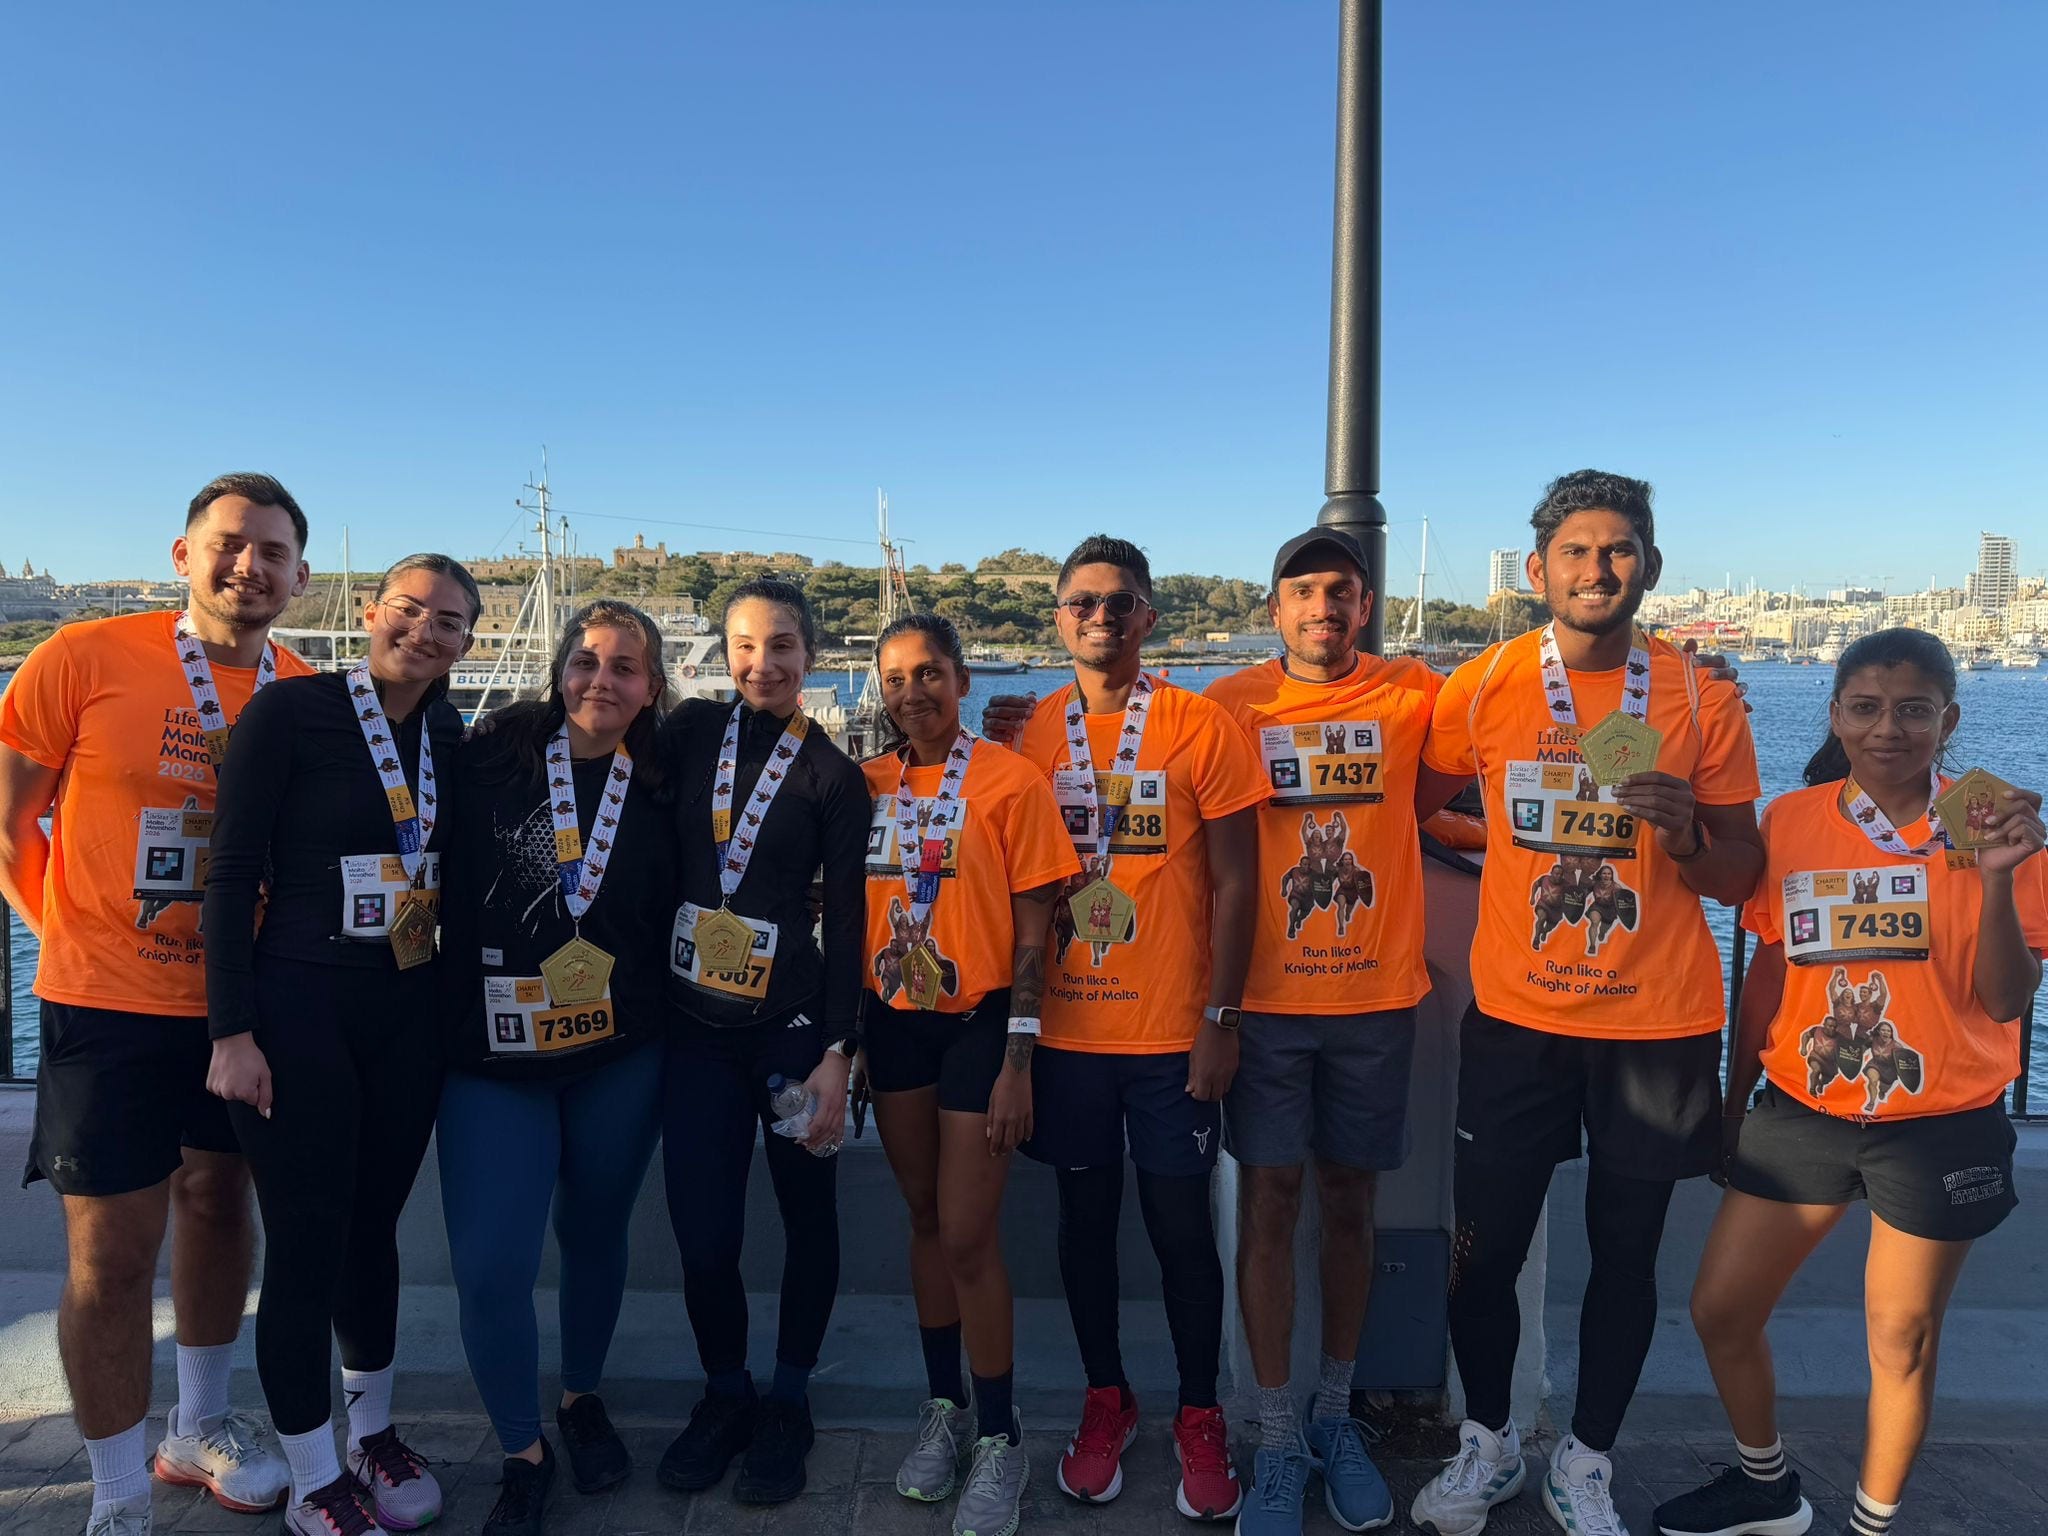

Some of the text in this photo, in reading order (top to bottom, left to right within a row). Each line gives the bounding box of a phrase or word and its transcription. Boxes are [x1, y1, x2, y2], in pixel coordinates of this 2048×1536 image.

[457, 675, 501, 684] BLUE
[162, 725, 206, 748] Malt
[160, 741, 211, 765] Mara
[158, 761, 205, 782] 2026
[1315, 762, 1378, 786] 7437
[1117, 814, 1161, 837] 438
[1561, 810, 1634, 839] 7436
[1815, 877, 1845, 885] CHARITY
[1838, 912, 1923, 939] 7439
[155, 933, 182, 948] Run
[137, 946, 201, 965] Knight of
[1302, 945, 1361, 958] Run like a
[1284, 959, 1378, 976] Knight of Malta
[1546, 960, 1617, 978] Run like a
[1063, 973, 1119, 986] Run like a
[1527, 971, 1637, 995] Knight of Malta
[1049, 986, 1138, 1002] Knight of Malta
[539, 1009, 608, 1042] 7369
